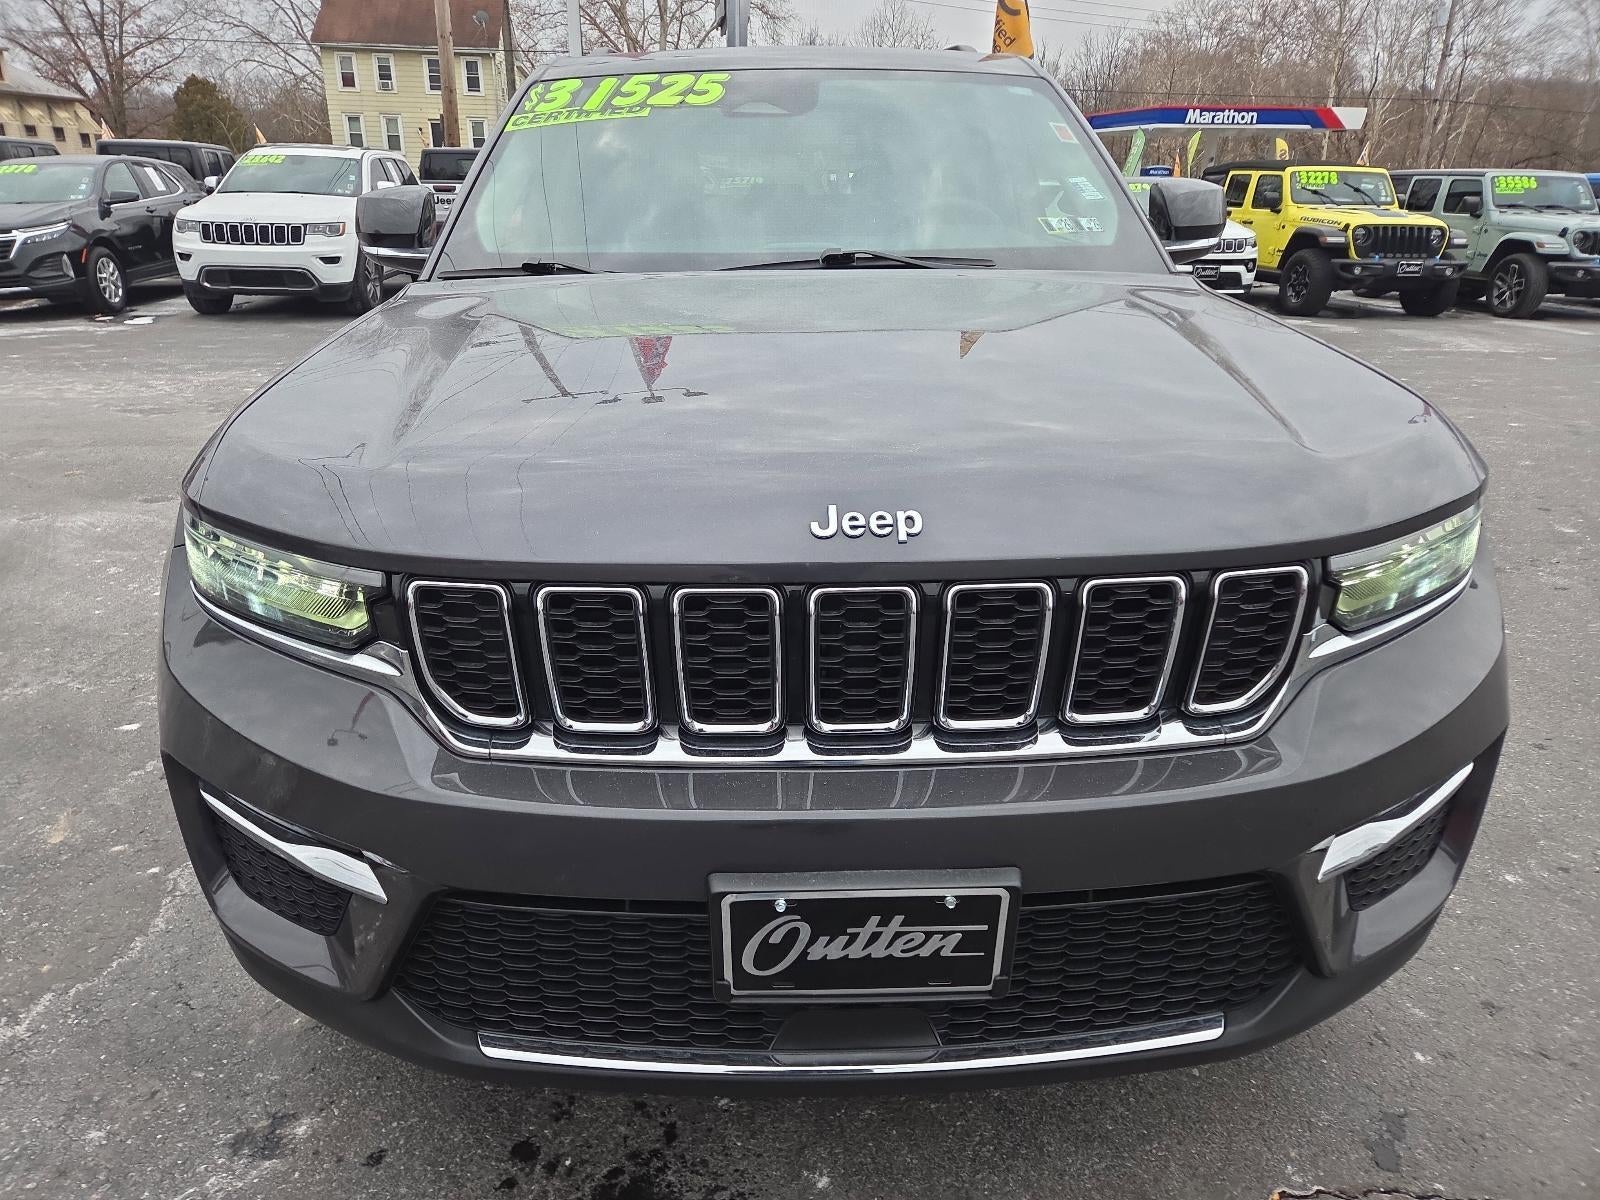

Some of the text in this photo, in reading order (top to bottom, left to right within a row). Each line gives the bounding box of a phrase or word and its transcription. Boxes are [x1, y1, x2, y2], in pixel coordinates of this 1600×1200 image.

[523, 73, 732, 112] $31525
[1184, 108, 1258, 125] Marathon
[1300, 215, 1342, 226] RUBICON
[809, 503, 924, 545] Jeep
[741, 914, 989, 977] Outten
